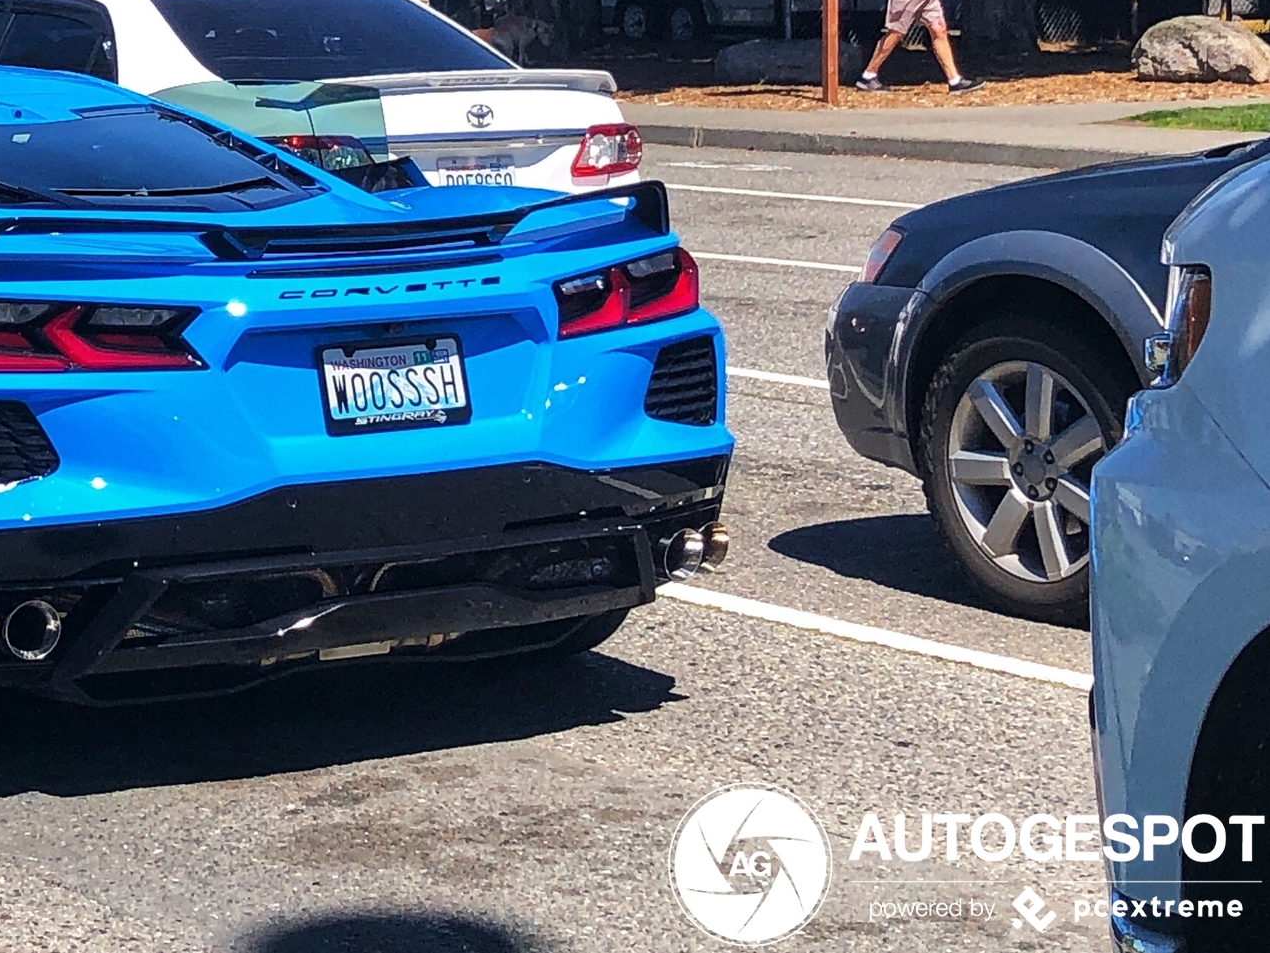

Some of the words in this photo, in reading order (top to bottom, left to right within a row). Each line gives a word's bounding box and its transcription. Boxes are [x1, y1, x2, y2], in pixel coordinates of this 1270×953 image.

[278, 276, 500, 299] CORVETTE
[330, 354, 407, 371] WASHINGTON
[414, 351, 428, 364] 11
[332, 365, 459, 415] WOOSSSH
[354, 409, 436, 426] STINGRAY
